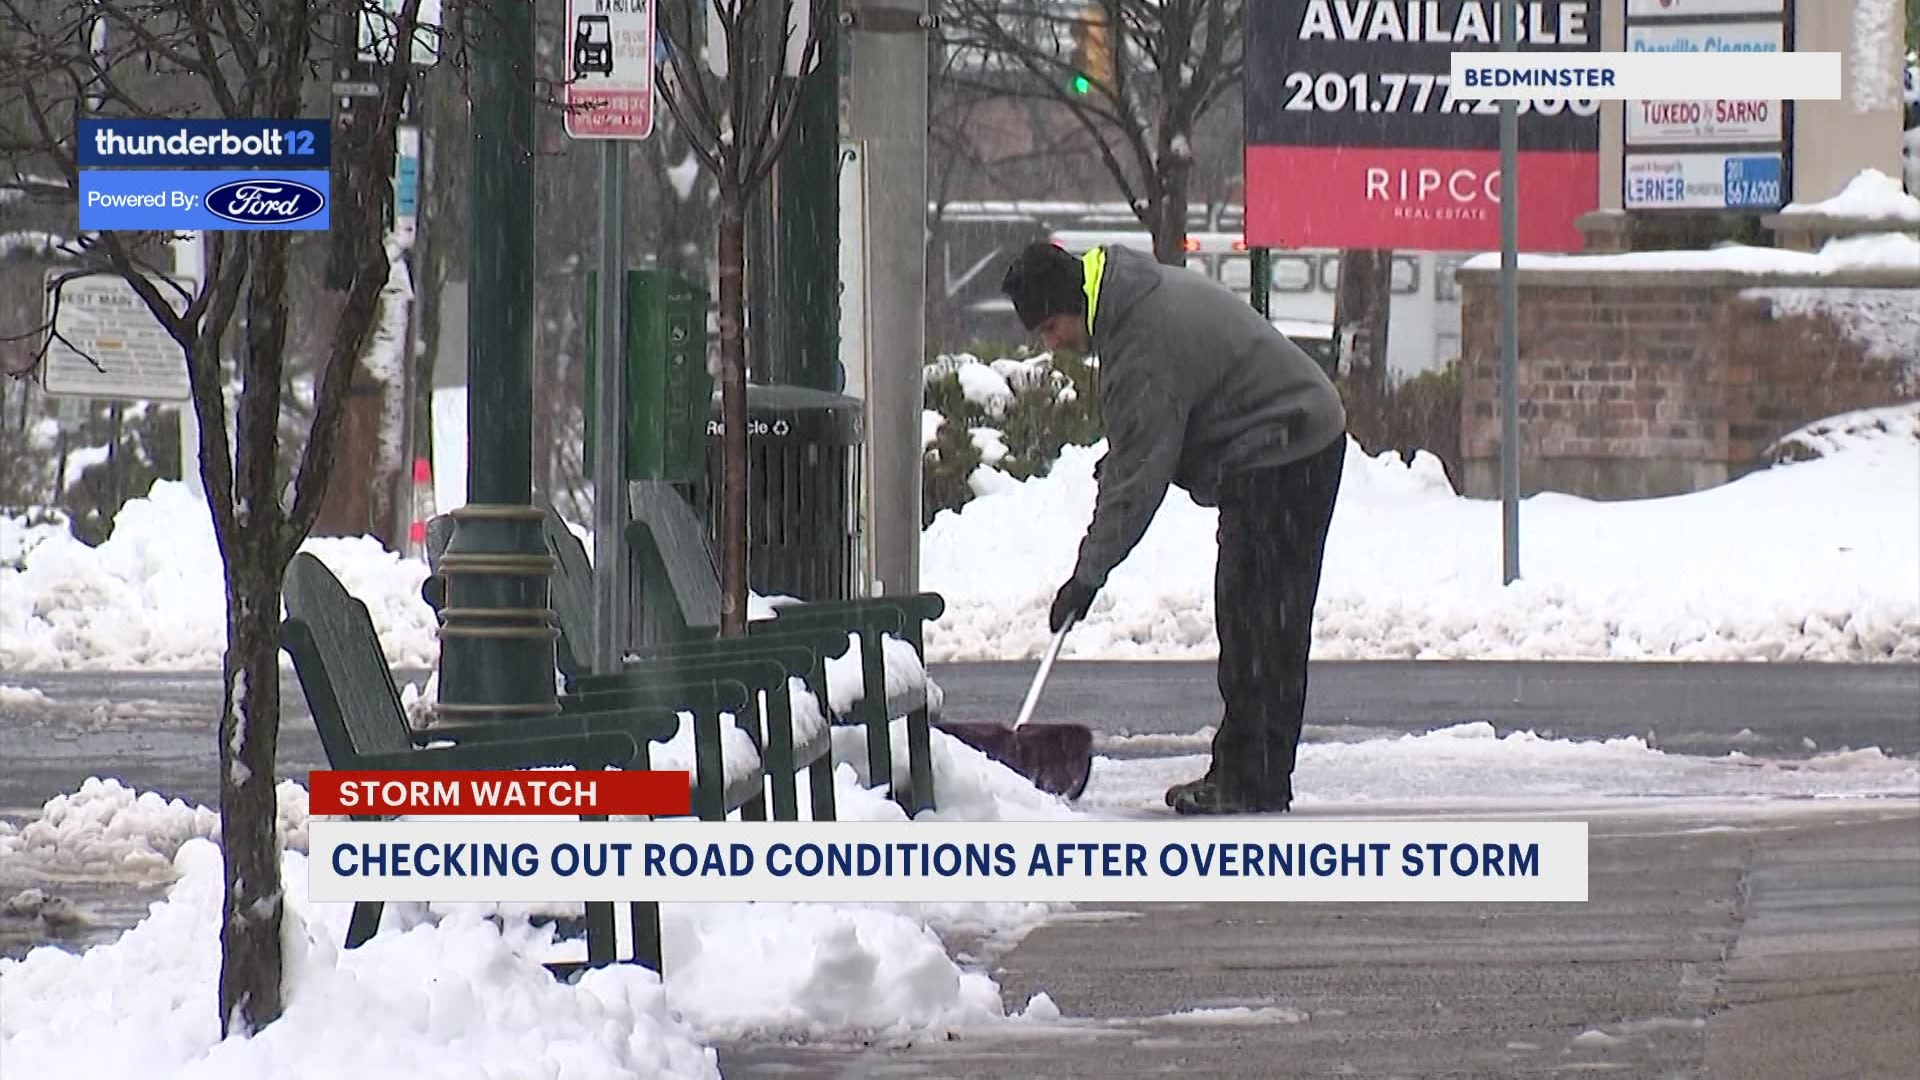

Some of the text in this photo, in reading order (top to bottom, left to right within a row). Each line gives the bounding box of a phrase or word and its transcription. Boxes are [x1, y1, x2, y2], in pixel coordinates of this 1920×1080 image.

[1284, 72, 1599, 116] 201.777.
[1642, 100, 1700, 124] TUXEDO
[1717, 99, 1768, 122] SARNO
[1628, 178, 1685, 202] LERNER
[1395, 206, 1487, 220] REAL ESTATE
[706, 420, 769, 436] Recle
